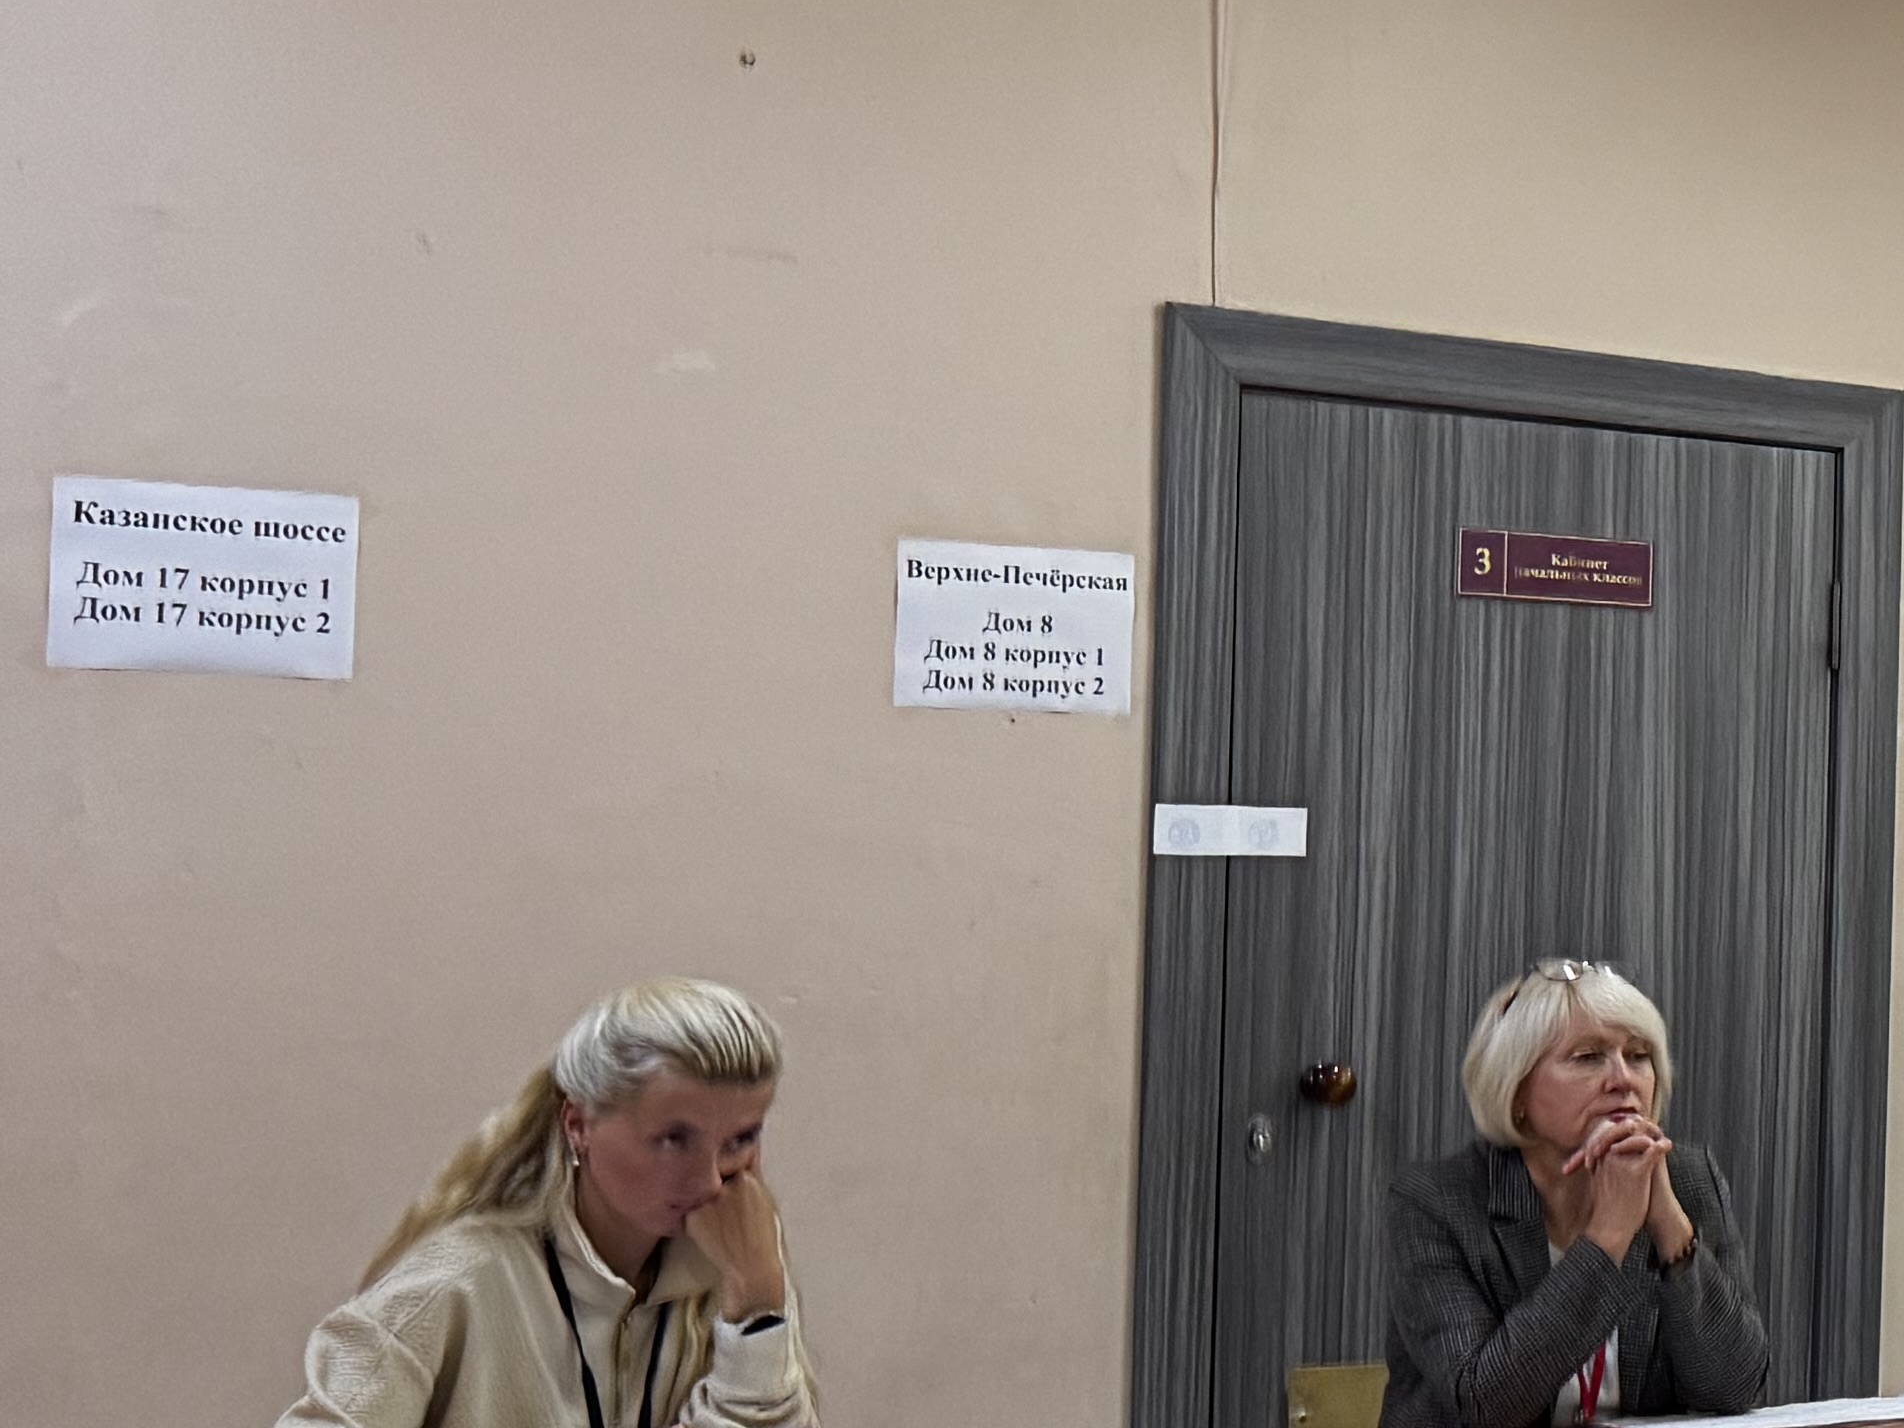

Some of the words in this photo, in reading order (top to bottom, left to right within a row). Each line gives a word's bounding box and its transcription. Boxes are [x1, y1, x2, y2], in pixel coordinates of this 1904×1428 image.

[73, 500, 243, 536] Казанское
[253, 520, 346, 543] шоссе
[906, 558, 1128, 594] Верхне-Печёрская
[1473, 547, 1492, 576] 3
[1551, 553, 1610, 571] Кабинет
[75, 560, 144, 589] Дом
[158, 566, 190, 590] 17
[199, 574, 308, 603] корпус
[320, 578, 331, 600] 1
[73, 596, 141, 625] Дом
[156, 601, 188, 627] 17
[198, 608, 307, 637] корпус
[315, 611, 331, 635] 2
[981, 610, 1032, 635] Дом
[1040, 614, 1053, 634] 8
[923, 638, 975, 663] Дом
[983, 641, 996, 662] 8
[1004, 646, 1087, 671] корпус
[1097, 647, 1104, 667] 1
[922, 668, 974, 694] Дом
[982, 672, 996, 692] 8
[1003, 676, 1086, 700] корпус
[1092, 677, 1105, 696] 2
